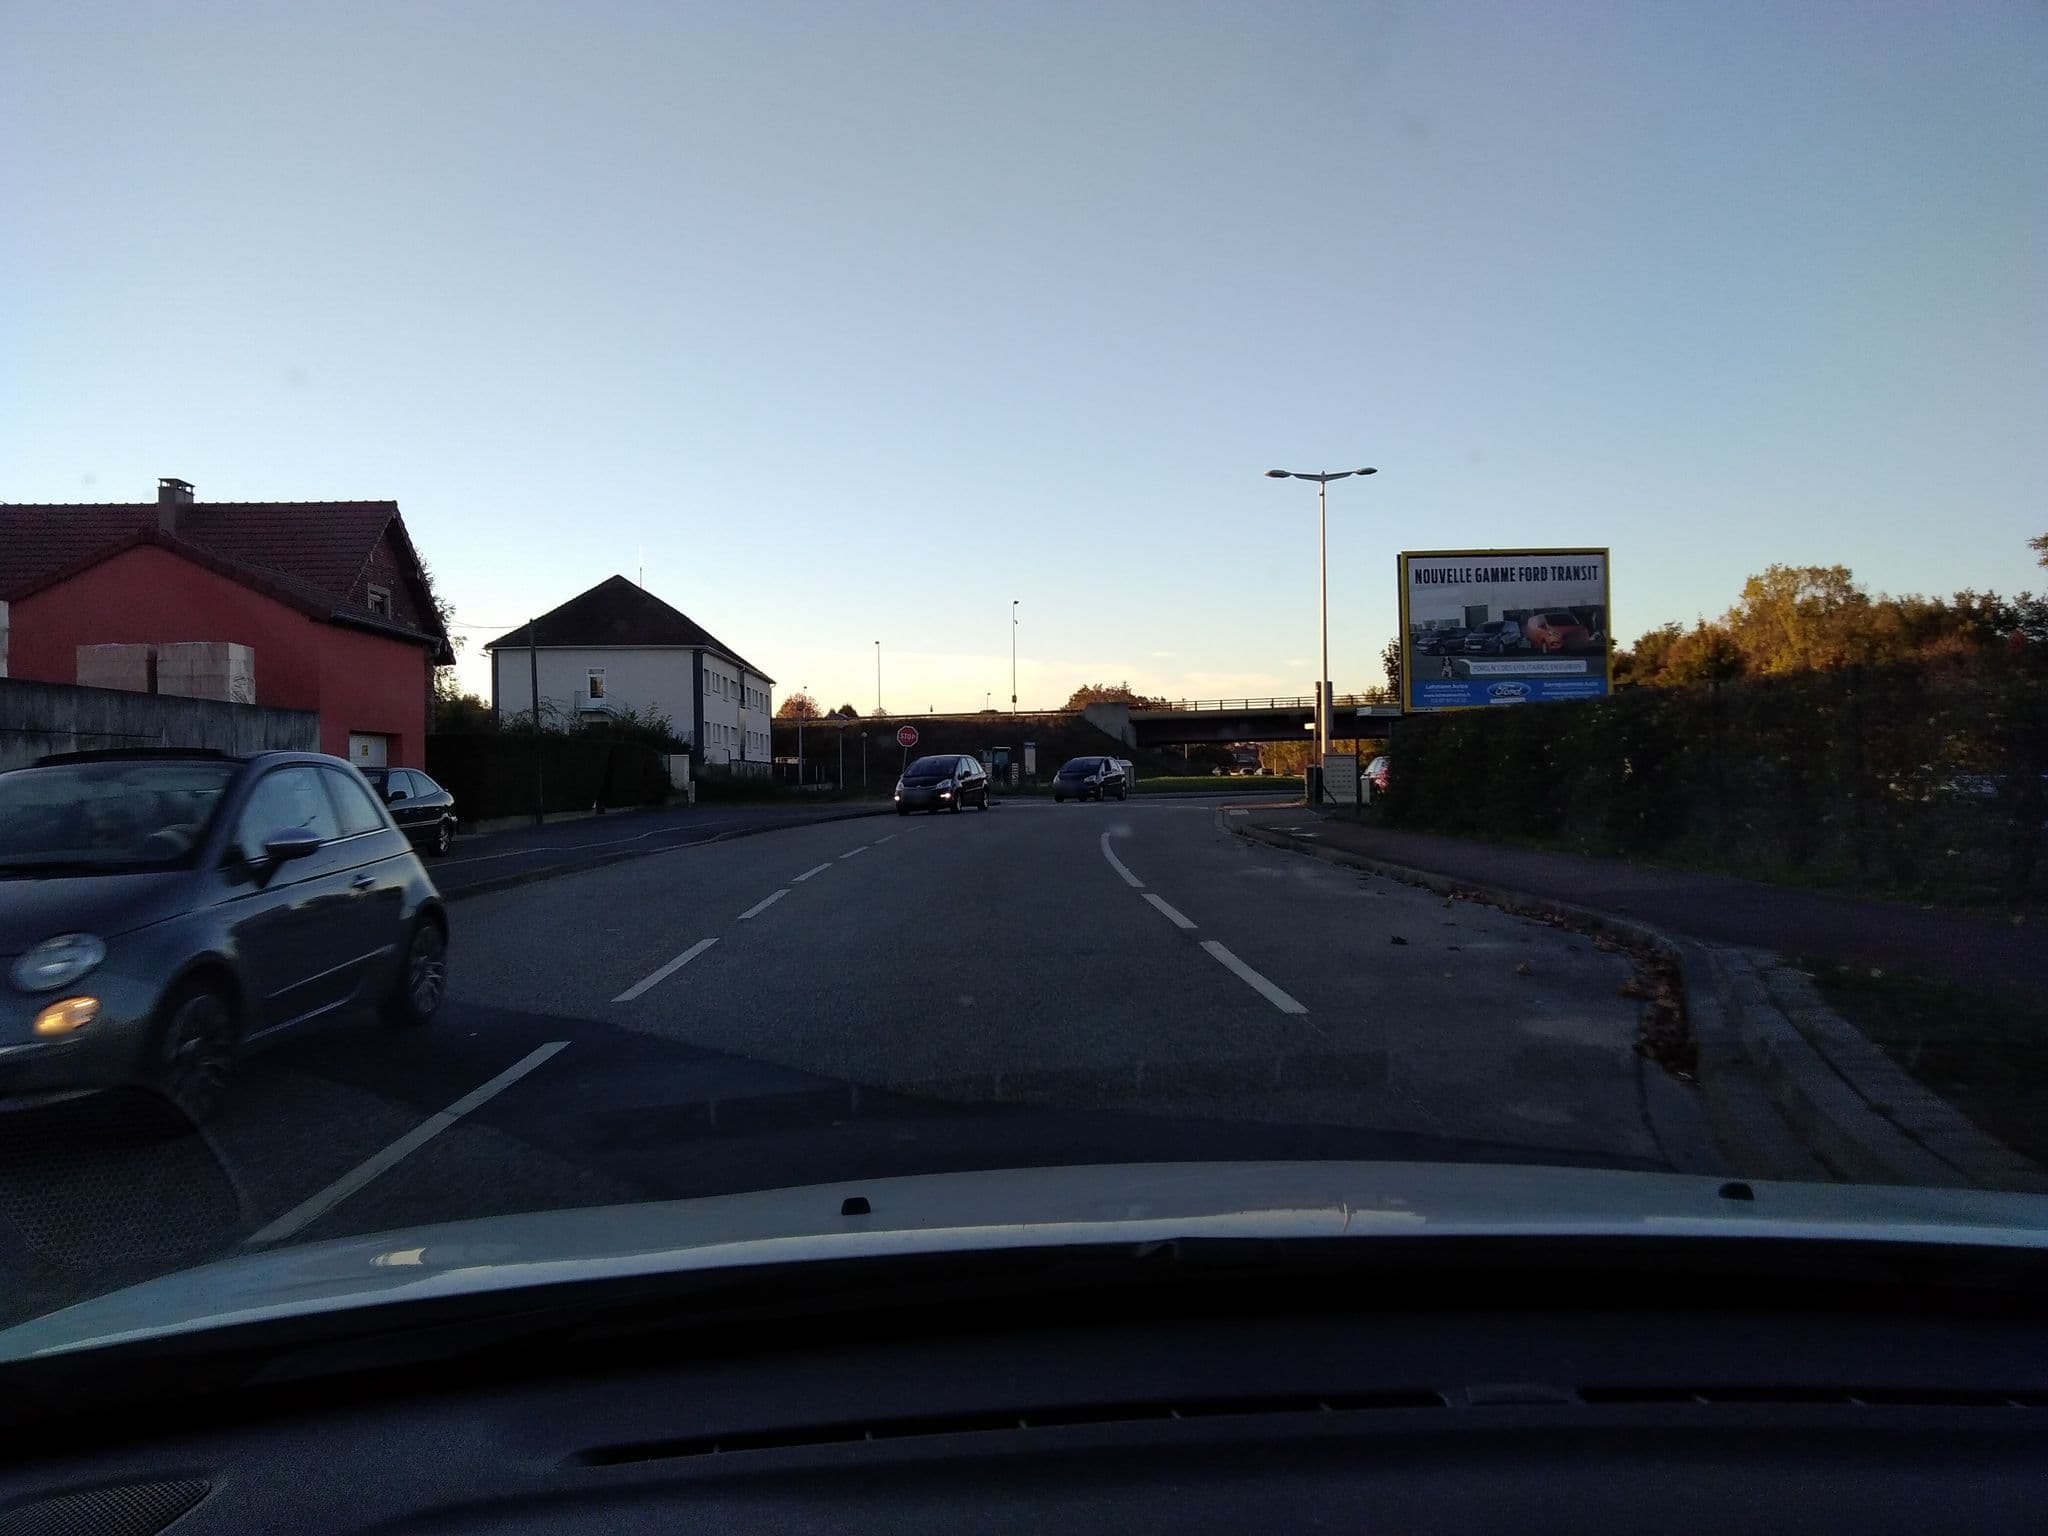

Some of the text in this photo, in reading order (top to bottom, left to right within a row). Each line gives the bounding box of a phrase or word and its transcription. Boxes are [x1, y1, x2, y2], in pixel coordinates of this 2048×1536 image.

[1415, 565, 1598, 584] NOUVELLE GAMME FORD TRANSIT
[1495, 686, 1522, 697] Ford
[899, 732, 916, 741] STOP
